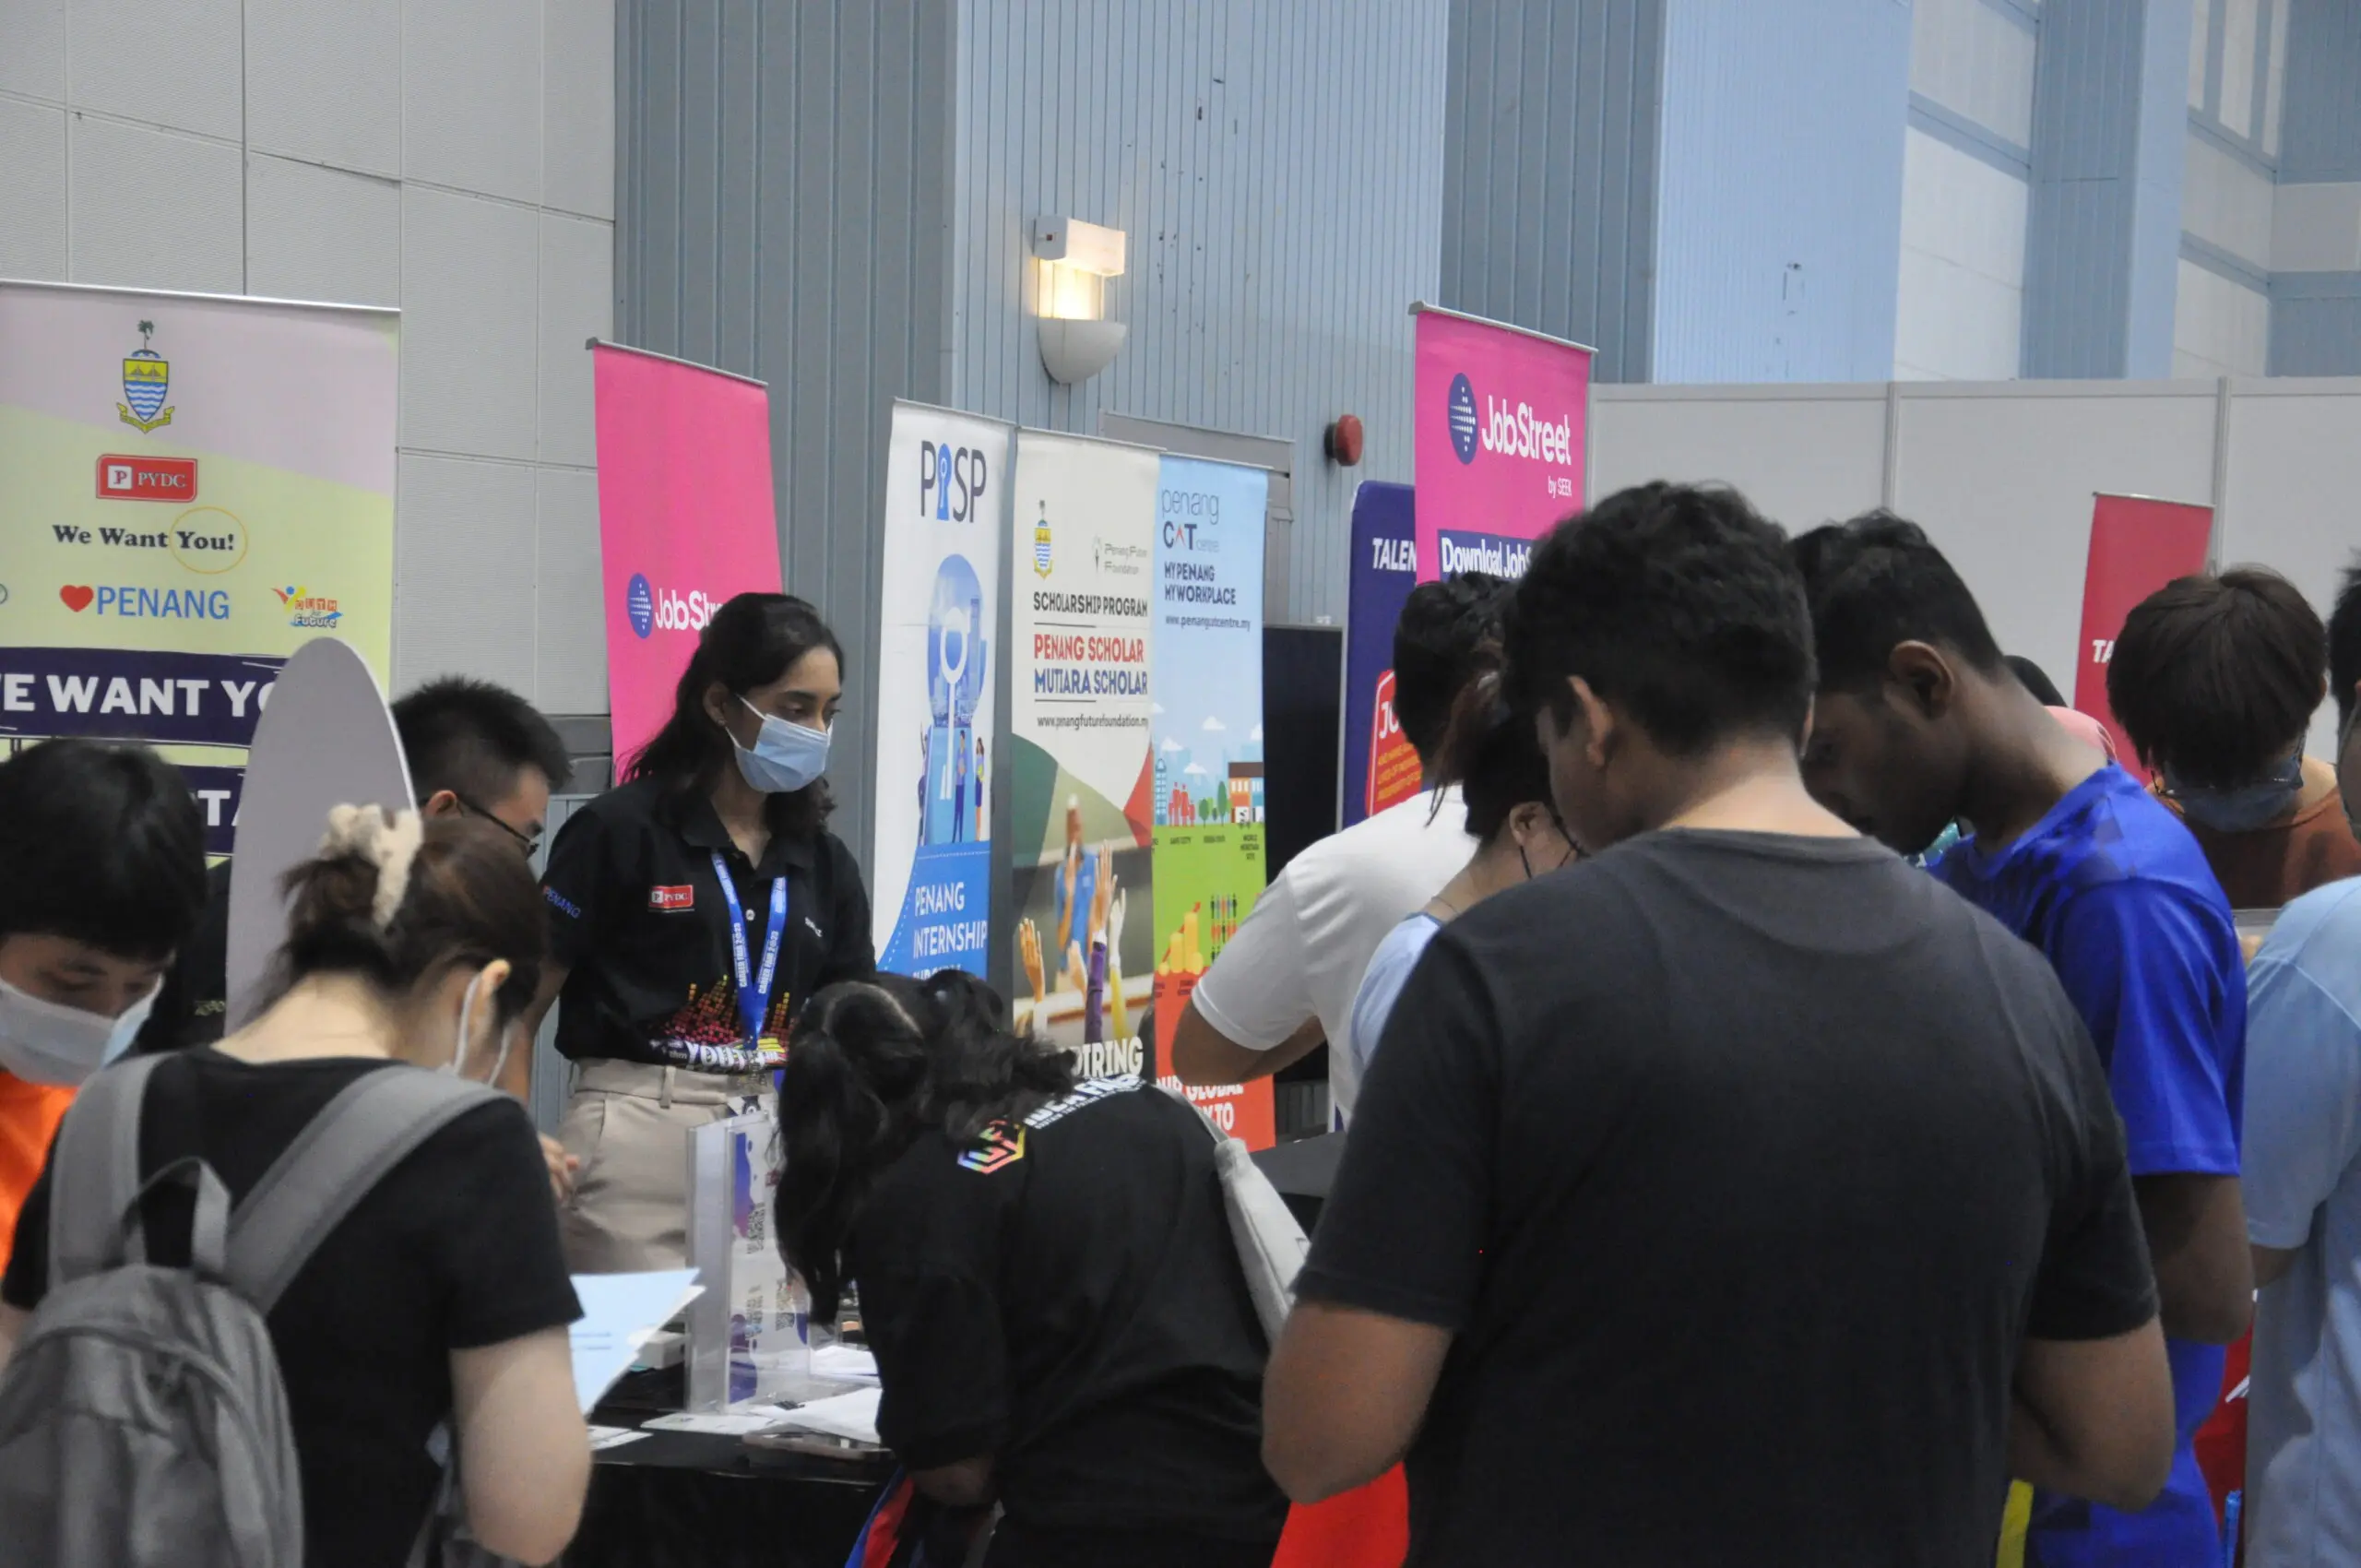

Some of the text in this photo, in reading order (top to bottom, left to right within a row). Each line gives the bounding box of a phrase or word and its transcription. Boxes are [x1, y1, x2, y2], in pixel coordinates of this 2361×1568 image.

[1481, 395, 1572, 466] JobStreet
[137, 471, 187, 488] PYDC
[1548, 475, 1557, 498] by
[1161, 489, 1219, 525] penang
[53, 525, 234, 551] We Want You!
[1371, 537, 1418, 572] TALEN
[1441, 537, 1533, 579] Download JobS
[97, 586, 230, 620] PENANG
[655, 588, 724, 631] JobStr
[1034, 591, 1148, 617] SCHOLARSHIP PROGRAM
[1034, 634, 1145, 663] PENANG SCHOLAR
[2092, 638, 2116, 663] TA
[0, 673, 36, 712] E
[46, 674, 209, 716] WANT
[1034, 667, 1148, 695] MUTIARA SCHOLAR
[914, 881, 965, 917] PENANG
[912, 920, 988, 959] INTERNSHIP
